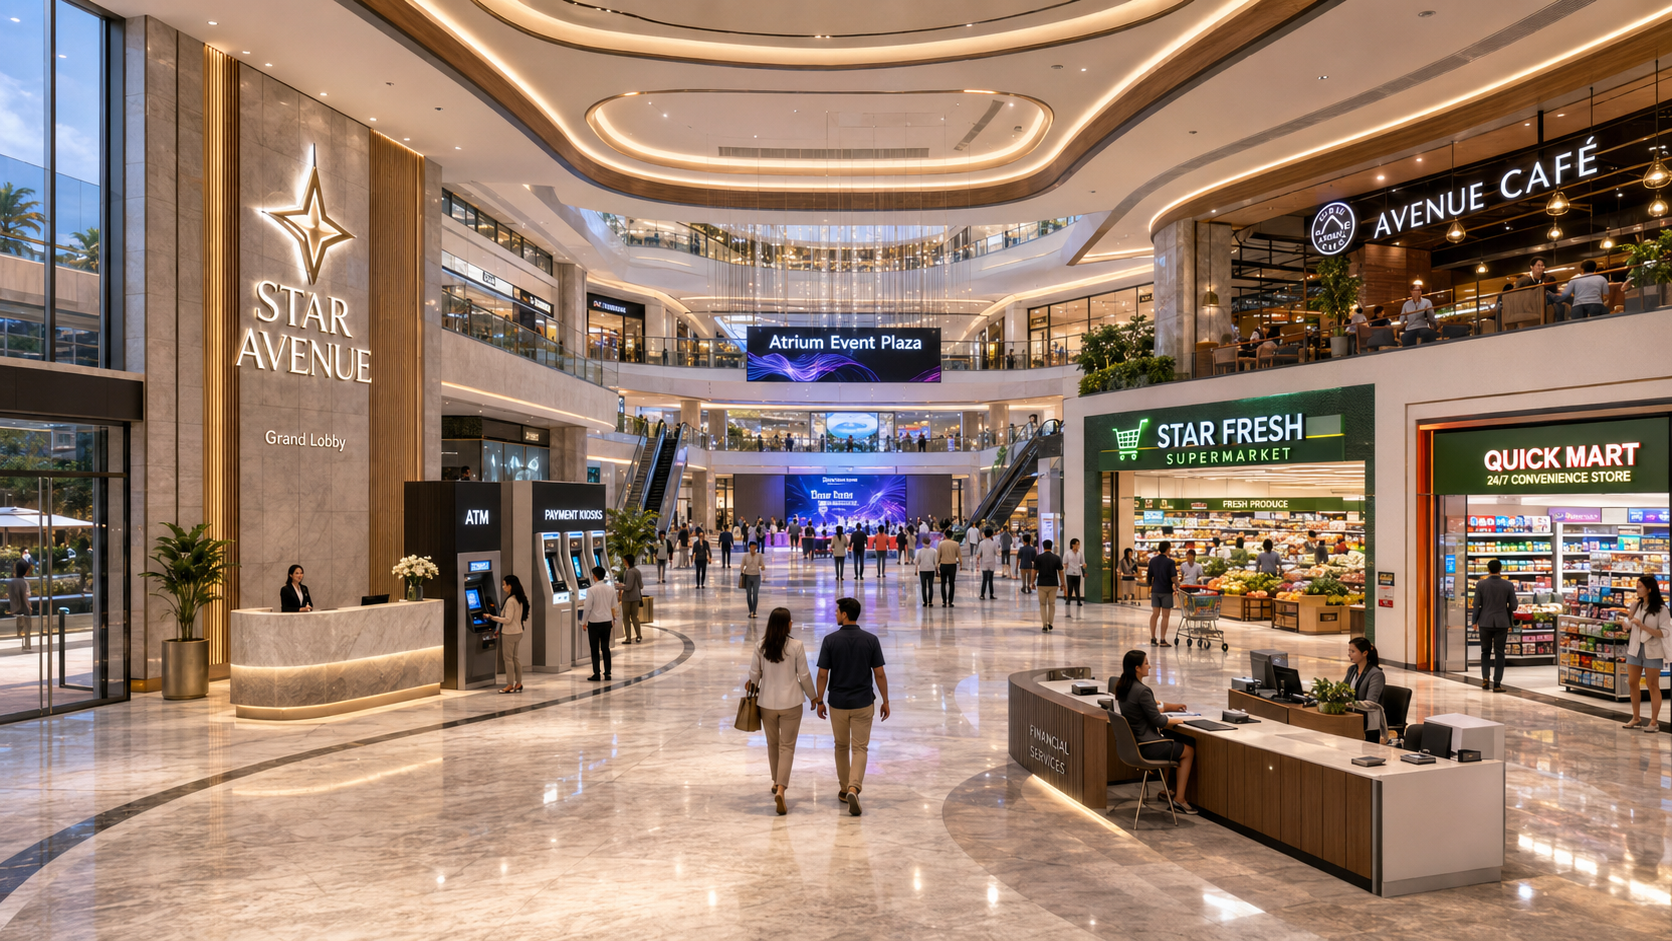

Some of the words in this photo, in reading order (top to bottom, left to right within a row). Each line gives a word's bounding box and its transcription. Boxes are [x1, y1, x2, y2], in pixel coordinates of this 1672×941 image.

[1374, 181, 1485, 239] AVENUE
[1500, 136, 1598, 199] CAFÉ
[256, 280, 353, 338] STAR
[769, 334, 824, 349] Atrium
[831, 335, 875, 349] Event
[881, 335, 922, 350] Plaza
[236, 328, 372, 384] AVENUE
[265, 430, 306, 446] Grand
[310, 433, 347, 452] Lobby
[1157, 421, 1216, 449] STAR
[1222, 413, 1303, 445] FRESH
[1166, 447, 1291, 465] SUPERMARKET
[1484, 446, 1561, 473] QUICK
[1565, 442, 1641, 468] MART
[1487, 475, 1509, 486] 24/7
[1511, 472, 1589, 485] CONVENIENCE
[1591, 470, 1632, 483] STORE
[465, 509, 490, 525] ATM
[545, 509, 578, 520] PAYMENT
[1222, 500, 1248, 509] FRESH
[1250, 500, 1289, 509] PRODUCE
[1030, 724, 1070, 756] FINANCIAL
[1030, 745, 1066, 775] SERVICES
